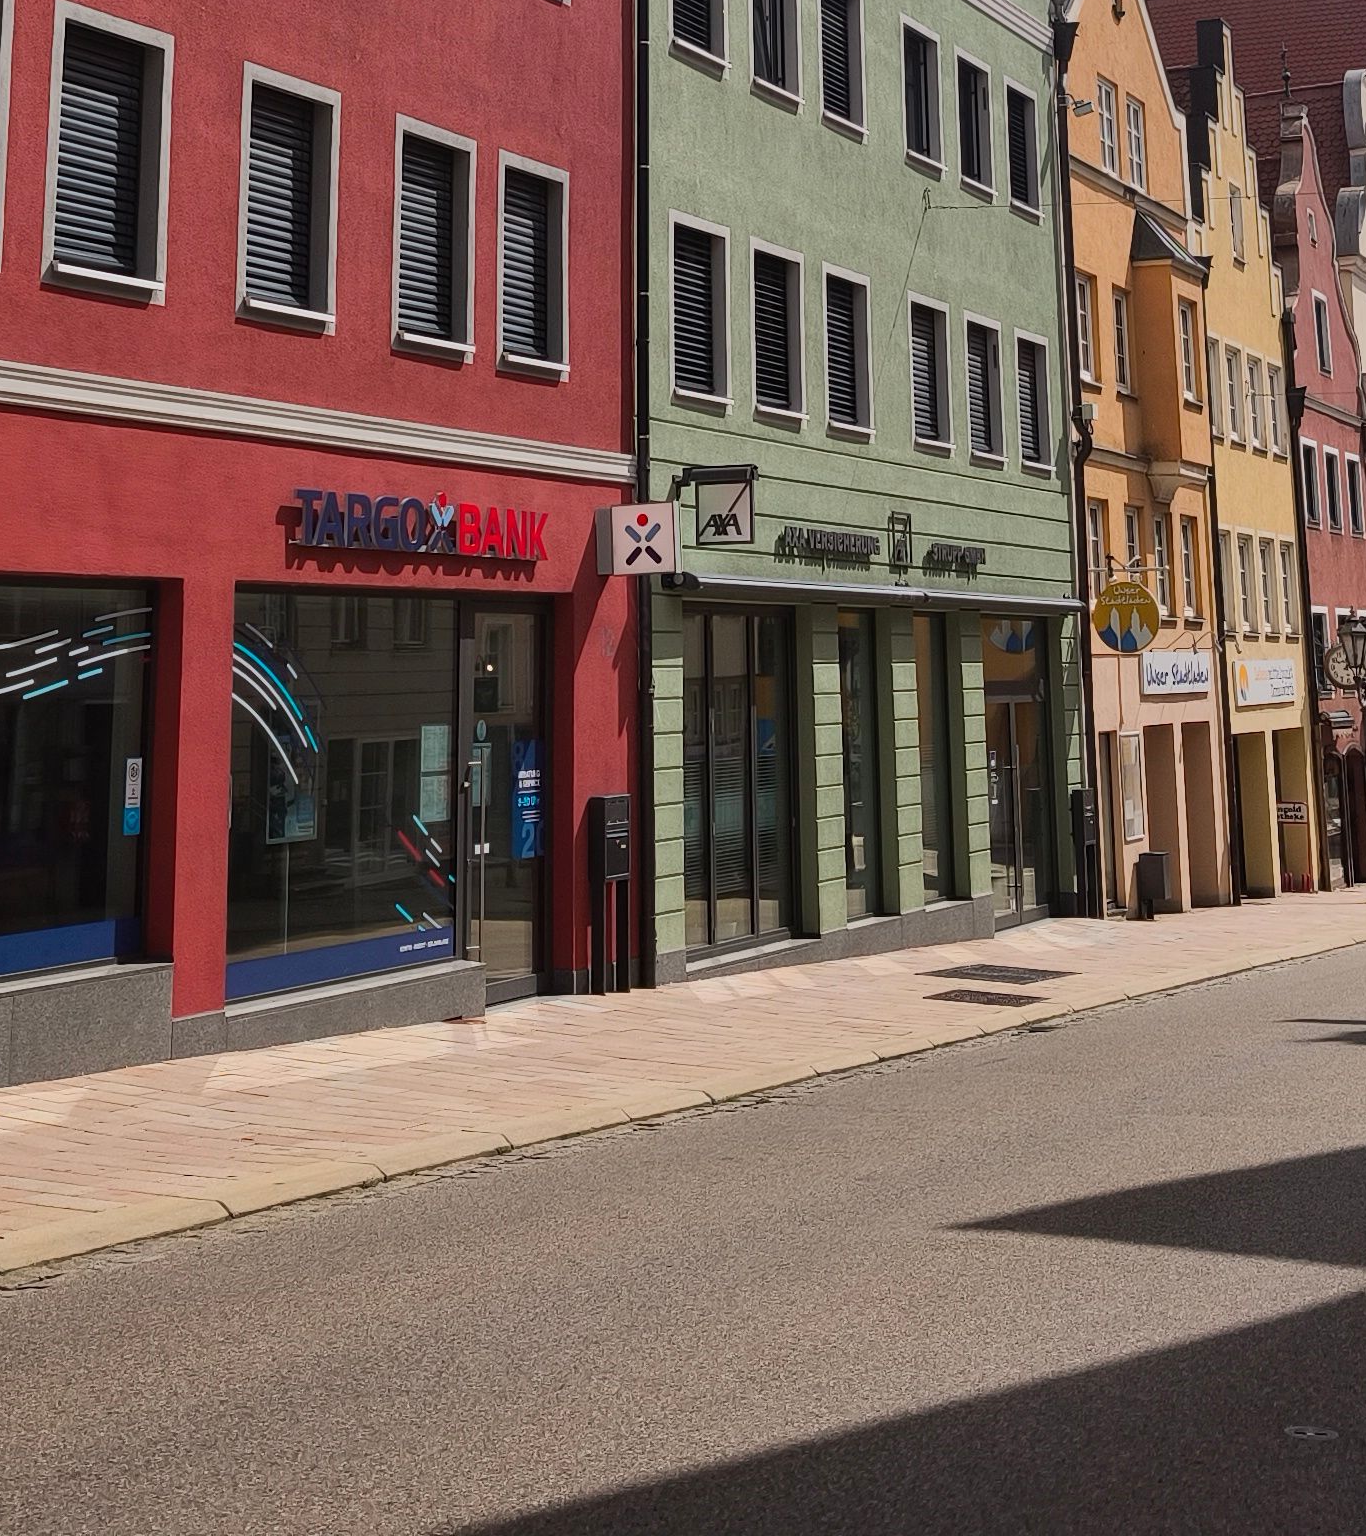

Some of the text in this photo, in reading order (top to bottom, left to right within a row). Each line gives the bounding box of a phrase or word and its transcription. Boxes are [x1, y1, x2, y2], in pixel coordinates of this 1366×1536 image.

[699, 513, 742, 537] AXA
[784, 526, 806, 547] AXA
[808, 529, 881, 556] VERSICHERUNG
[1146, 660, 1209, 686] Unser Stadtladen
